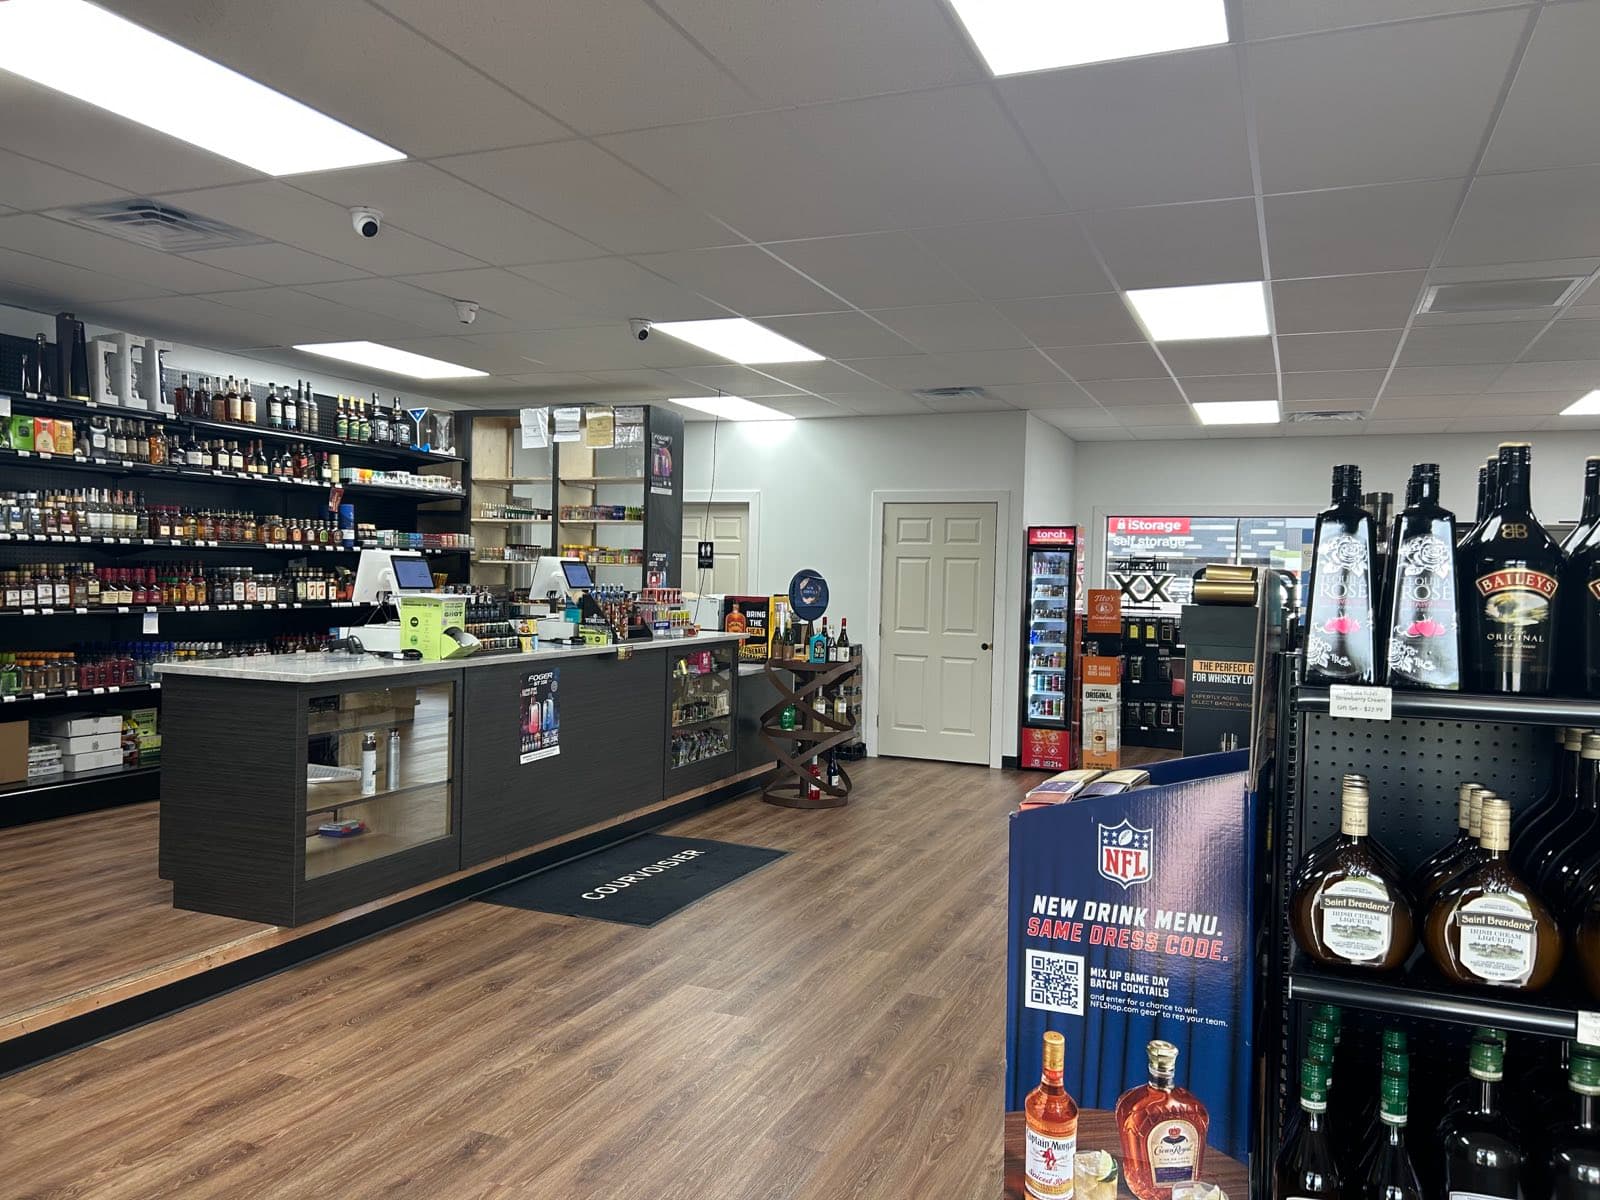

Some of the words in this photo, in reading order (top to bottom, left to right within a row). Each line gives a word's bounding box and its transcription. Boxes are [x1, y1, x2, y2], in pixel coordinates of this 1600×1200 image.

[1036, 529, 1067, 539] torch
[1128, 520, 1182, 533] iStorage
[1113, 536, 1136, 546] Self
[1138, 536, 1186, 549] storage
[1482, 572, 1553, 593] BAILEYS
[1320, 584, 1368, 599] ROSE
[1402, 585, 1452, 601] ROSE
[1487, 633, 1545, 643] ORIGINAL
[1200, 661, 1213, 671] THE
[1215, 662, 1247, 673] PERFECT
[528, 672, 553, 681] FOGER
[1192, 672, 1207, 682] FOR
[1208, 674, 1242, 685] WHISKEY
[1085, 691, 1112, 700] ORIGINAL
[1105, 848, 1146, 879] NFL
[581, 849, 705, 900] COURVOISIER
[1325, 897, 1347, 907] Saint
[1348, 898, 1390, 913] Brendan's
[1033, 894, 1078, 919] NEW
[1083, 901, 1149, 928] DRINK
[1154, 909, 1223, 937] MENU.
[1461, 914, 1486, 925] Saint
[1487, 916, 1532, 931] Brendan's
[1027, 916, 1084, 943] SAME
[1089, 924, 1159, 952] DRESS
[1165, 934, 1229, 962] CODE.
[1478, 935, 1514, 945] LIQUEUR
[1090, 967, 1107, 979] MIX
[1110, 970, 1122, 980] UP
[1124, 972, 1149, 984] GAME
[1152, 976, 1170, 987] DAY
[1090, 979, 1118, 991] BATCH
[1120, 982, 1169, 998] COCKTAILS
[1090, 993, 1104, 1001] and
[1106, 995, 1126, 1005] enter
[1127, 997, 1138, 1006] for
[1146, 1001, 1173, 1012] chance
[1174, 1004, 1182, 1013] to
[1184, 1006, 1198, 1015] win
[1090, 1000, 1139, 1014] NFLShop.com
[1163, 1011, 1171, 1019] to
[1172, 1013, 1185, 1022] rep
[1186, 1015, 1204, 1025] your
[1205, 1017, 1229, 1027] team.
